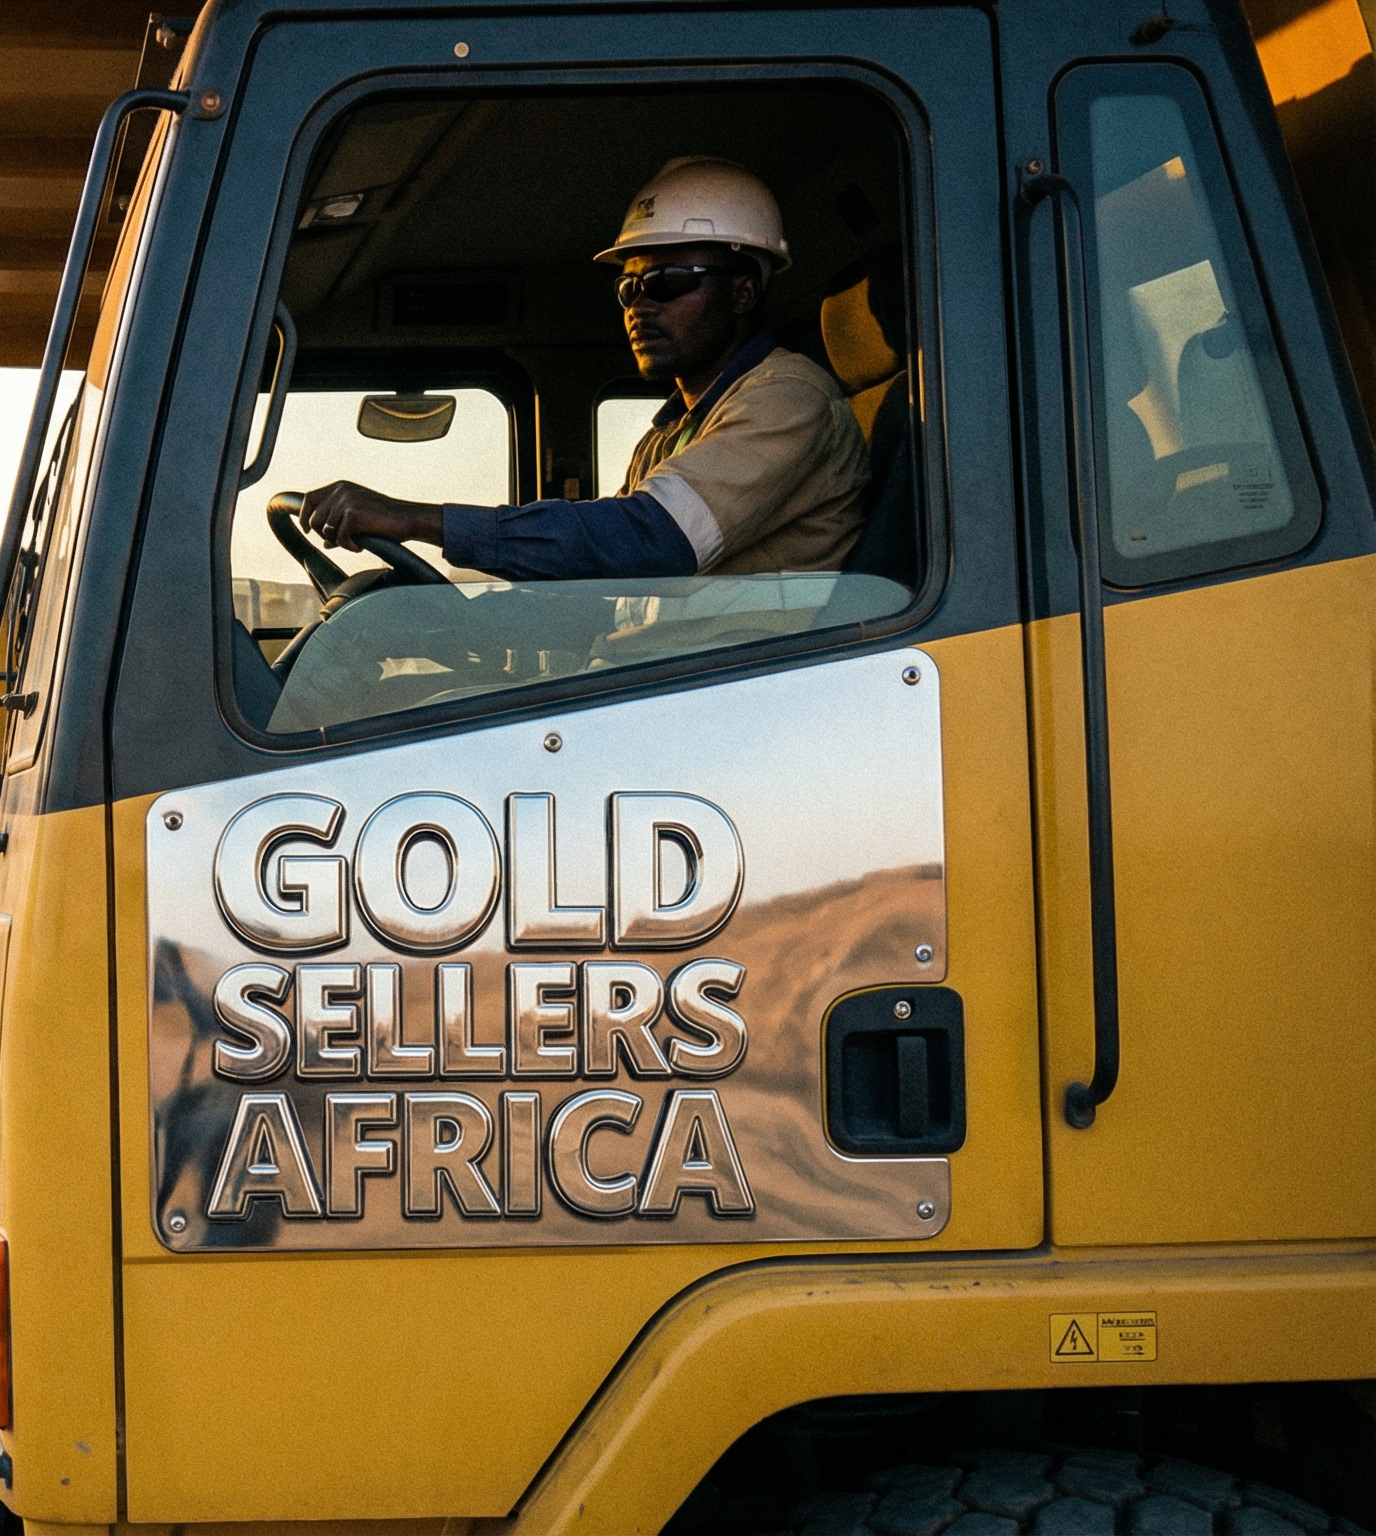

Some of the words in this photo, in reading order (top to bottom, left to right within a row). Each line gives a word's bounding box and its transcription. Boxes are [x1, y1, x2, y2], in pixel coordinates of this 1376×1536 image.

[213, 790, 745, 957] GOLD
[212, 958, 748, 1083] SELLERS
[206, 1088, 756, 1220] AFRICA
